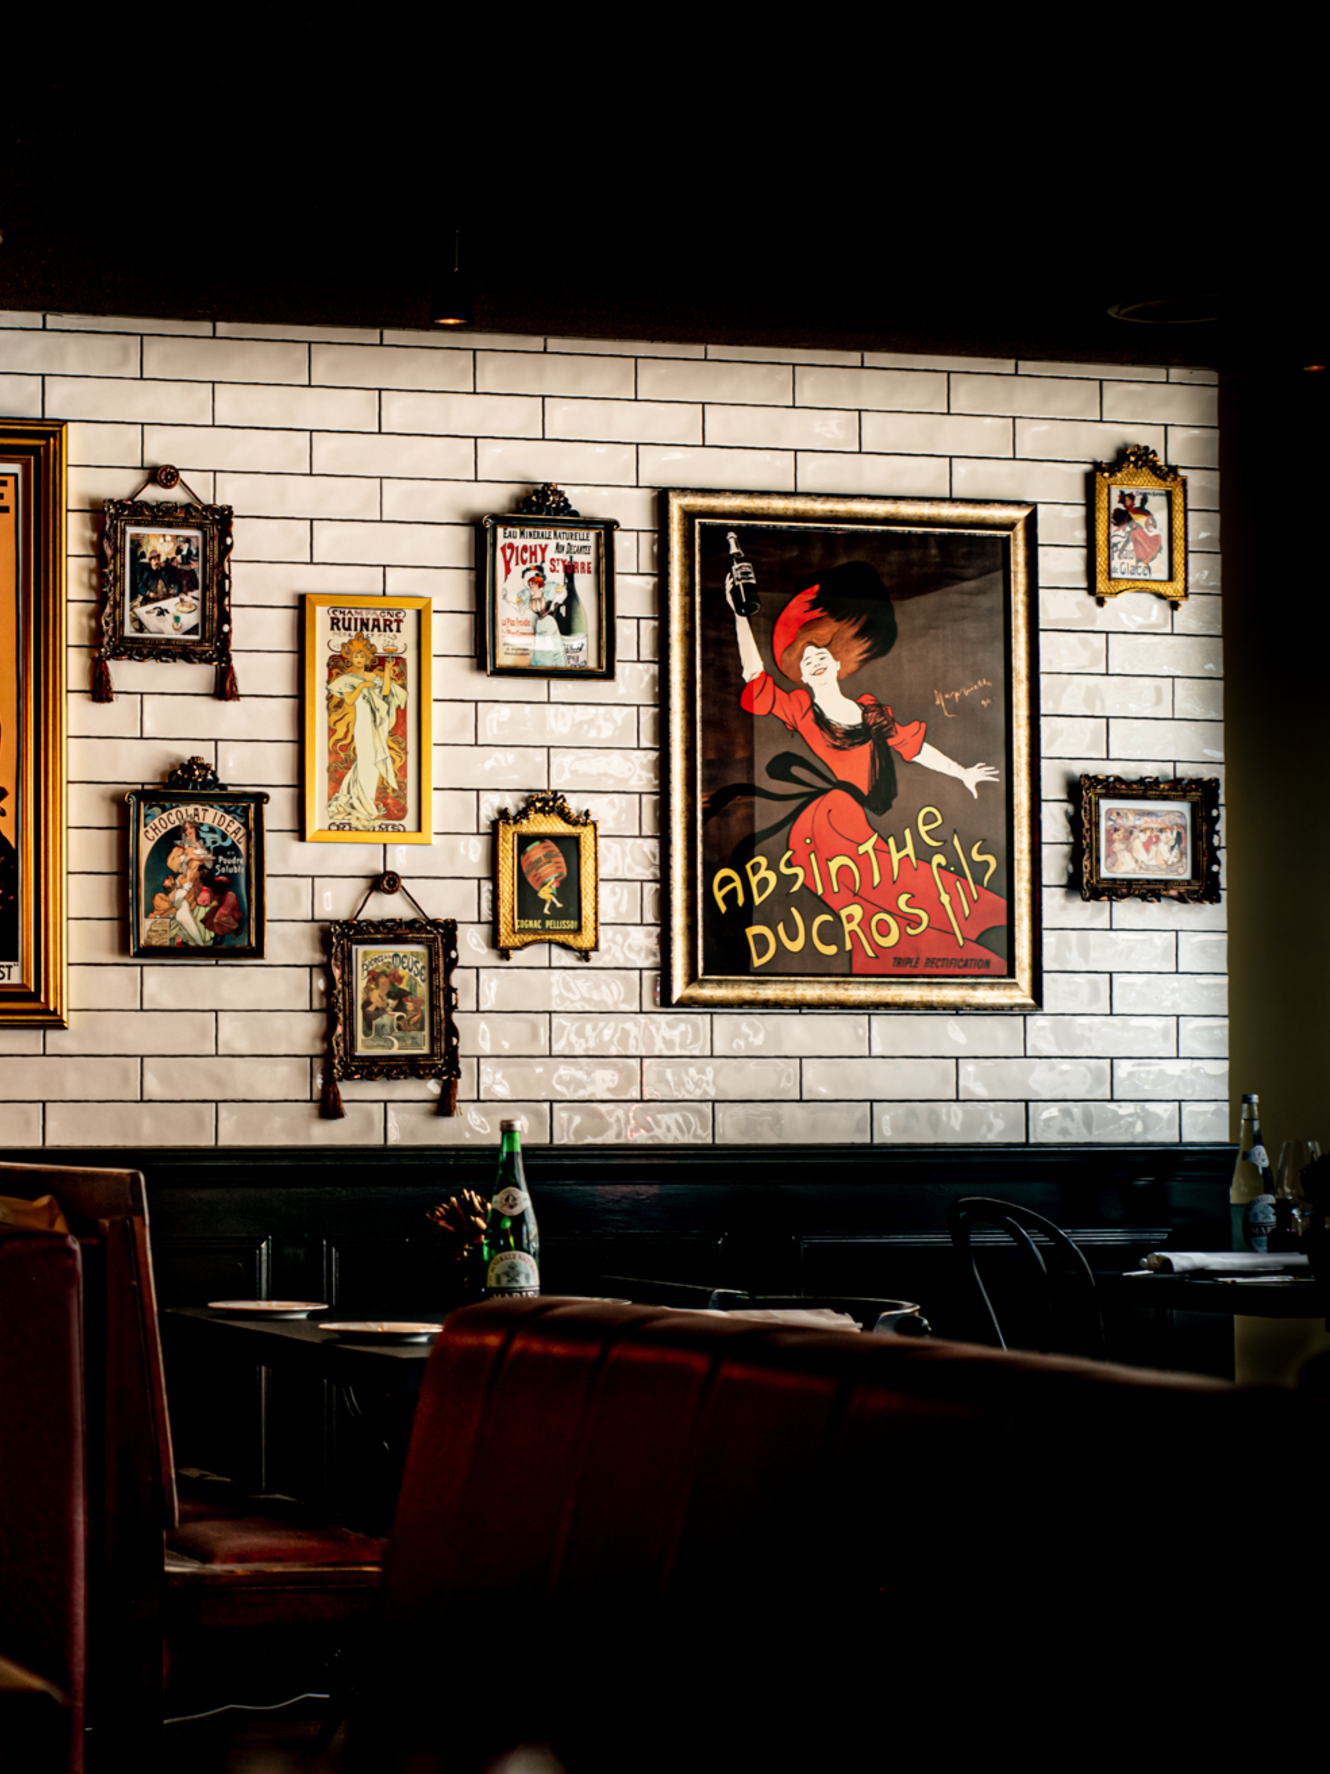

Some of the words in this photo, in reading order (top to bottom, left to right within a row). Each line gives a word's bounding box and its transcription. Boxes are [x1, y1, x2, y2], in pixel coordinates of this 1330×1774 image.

[500, 541, 549, 583] VICHY
[1120, 561, 1148, 577] Glace
[330, 616, 403, 633] RUINART
[143, 807, 209, 842] CHOCOLAT
[745, 893, 930, 969] DUCROS
[930, 828, 998, 949] fils
[517, 919, 542, 929] COGNAC
[892, 957, 920, 969] TRIPLE
[923, 957, 992, 970] RECTIFICATION
